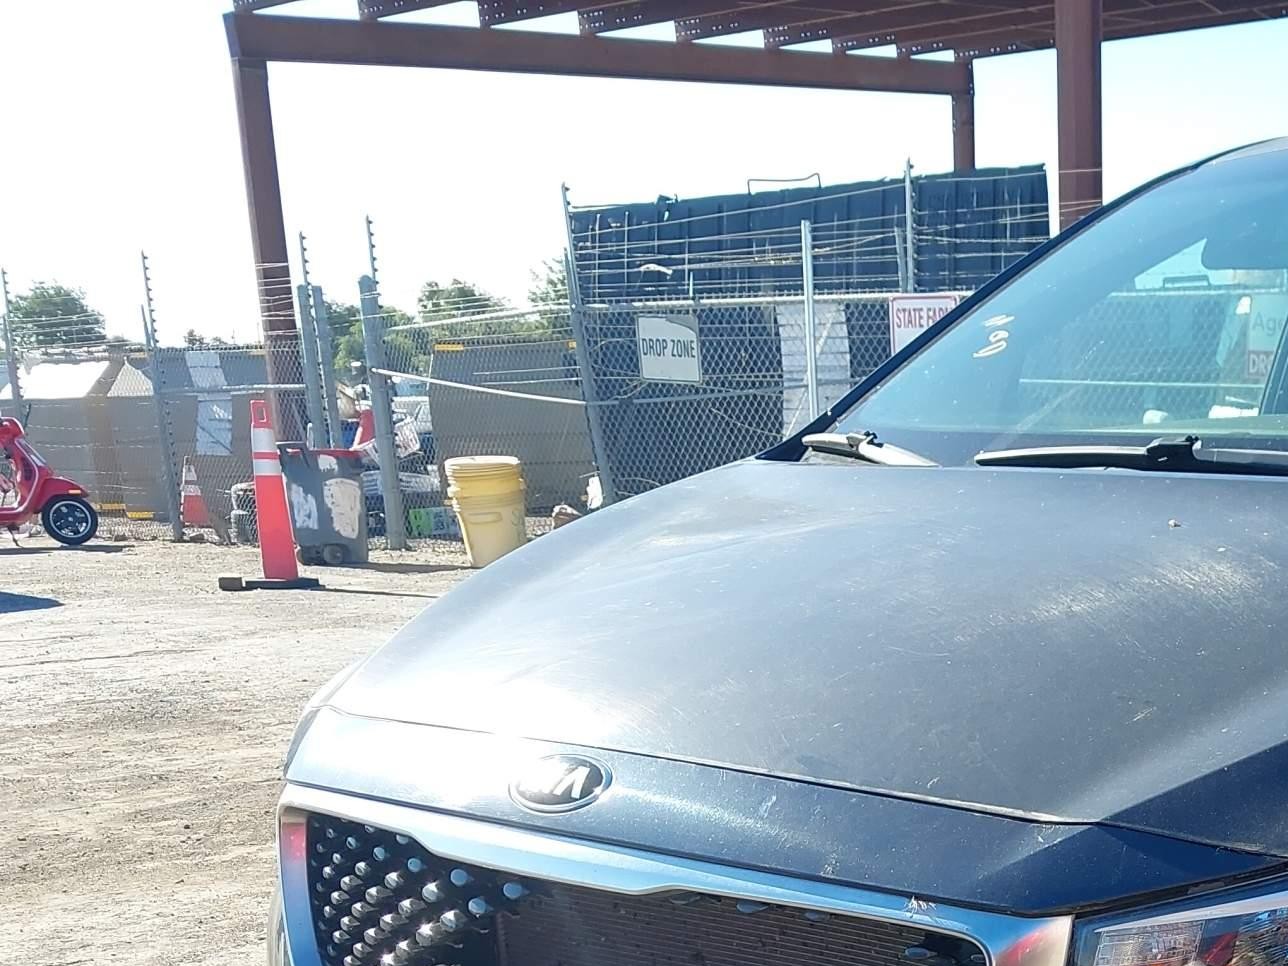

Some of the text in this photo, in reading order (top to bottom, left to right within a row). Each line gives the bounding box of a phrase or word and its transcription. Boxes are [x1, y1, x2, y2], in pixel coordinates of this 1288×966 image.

[895, 308, 953, 329] STATE FA
[641, 338, 696, 358] DROP ZONE
